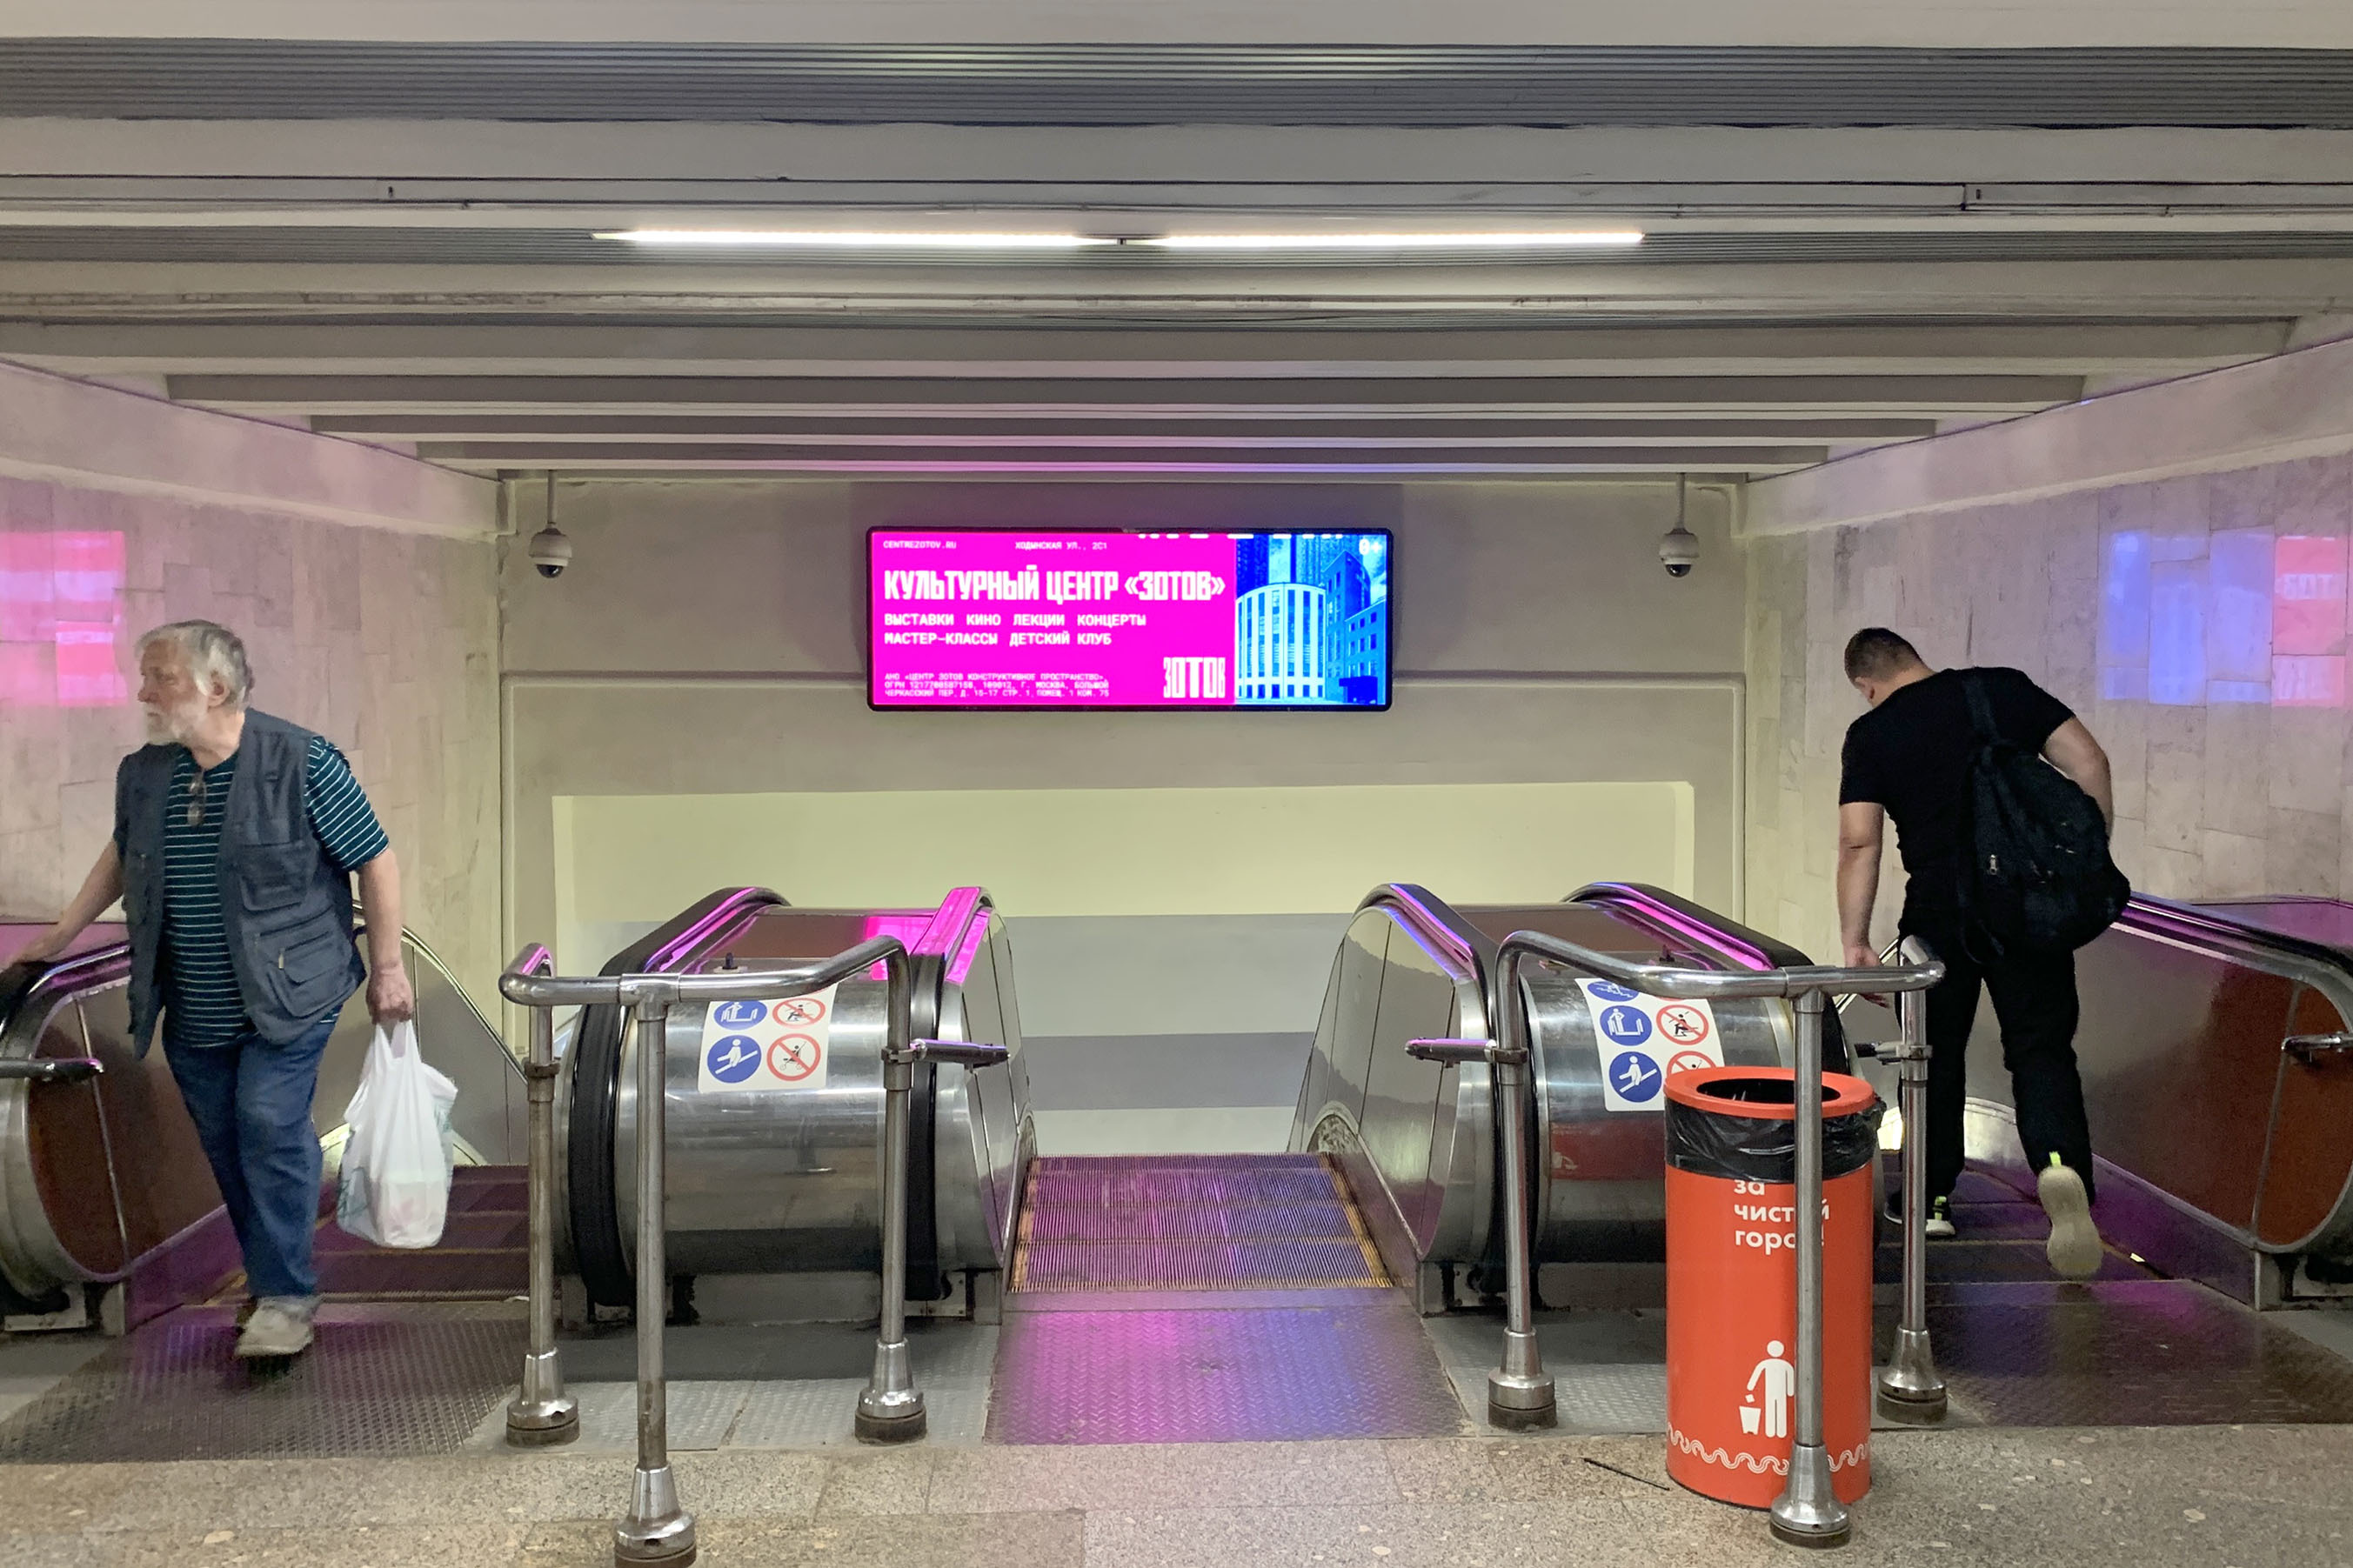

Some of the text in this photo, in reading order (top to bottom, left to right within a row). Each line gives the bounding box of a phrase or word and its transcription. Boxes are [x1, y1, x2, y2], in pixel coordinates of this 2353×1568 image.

[1015, 541, 1063, 550] ХОДЫНСКАЯ
[1359, 538, 1382, 555] 0+
[884, 564, 1226, 604] КУЛЬТУРНЫЙ ЦЕНТР «ЗОТОВ»
[885, 613, 1146, 628] ВЫСТАВКИ КИНО ЛЕКЦИИ КОНЦЕРТЫ
[885, 631, 1112, 646] МАСТЕР-КЛАССЫ ДЕТСКИЙ КЛУБ
[1163, 657, 1226, 698] ЗОТОВ
[1734, 1179, 1765, 1195] за
[1734, 1198, 1829, 1223] чистй
